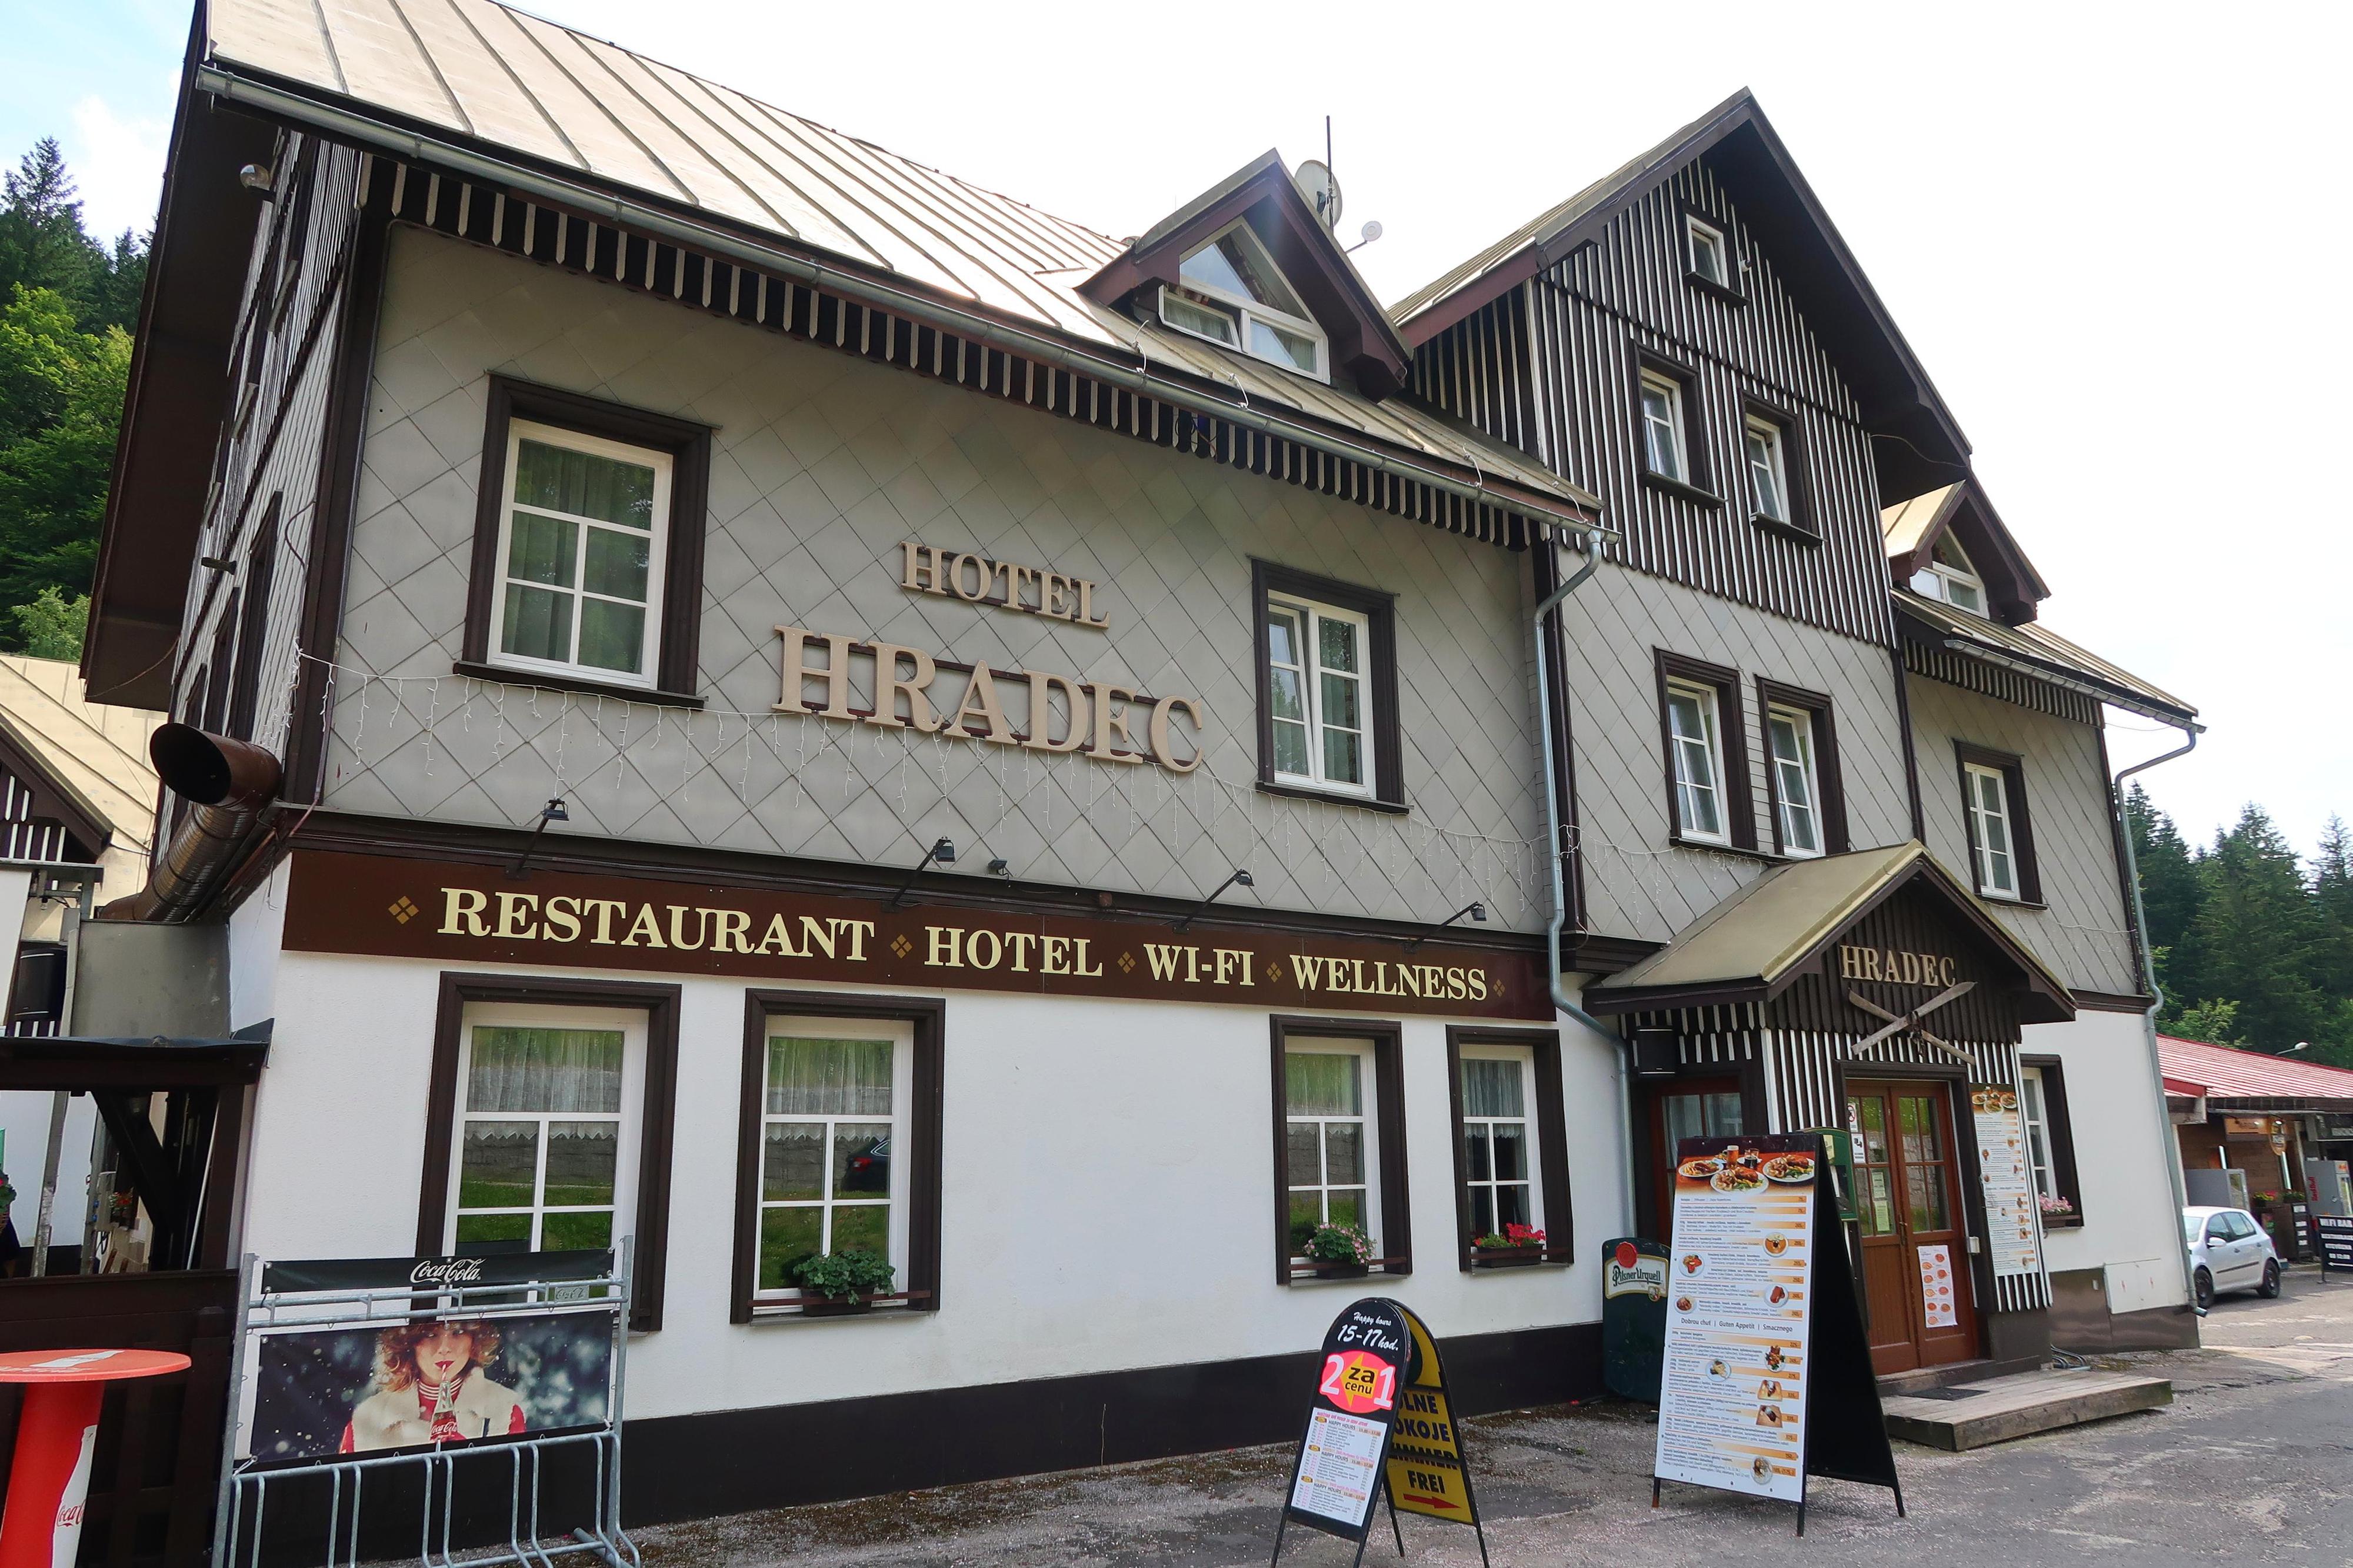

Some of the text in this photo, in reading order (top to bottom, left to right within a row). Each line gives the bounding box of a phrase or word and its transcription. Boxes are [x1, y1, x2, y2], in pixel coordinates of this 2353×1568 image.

[900, 541, 1110, 629] HOTEL
[771, 625, 1204, 773] HRADEC
[437, 888, 1487, 1002] RESTAURANT HOTEL WI-FI WELLNESS
[1840, 945, 1956, 987] HRADEC
[410, 1259, 487, 1283] Coca-Cola
[1612, 1265, 1661, 1287] Pilsner Urquell
[1354, 1312, 1392, 1326] Happy hours
[1681, 1317, 1699, 1326] Dobrou
[1735, 1322, 1755, 1330] Appetit
[1763, 1324, 1794, 1333] Smacznego
[1337, 1324, 1398, 1351] 15-17 hod.
[1321, 1355, 1395, 1408] 2 za 1
[1345, 1382, 1372, 1394] cenu
[1399, 1392, 1439, 1414] LNÉ
[1394, 1418, 1451, 1442] OKOJE
[1407, 1470, 1445, 1494] FREI
